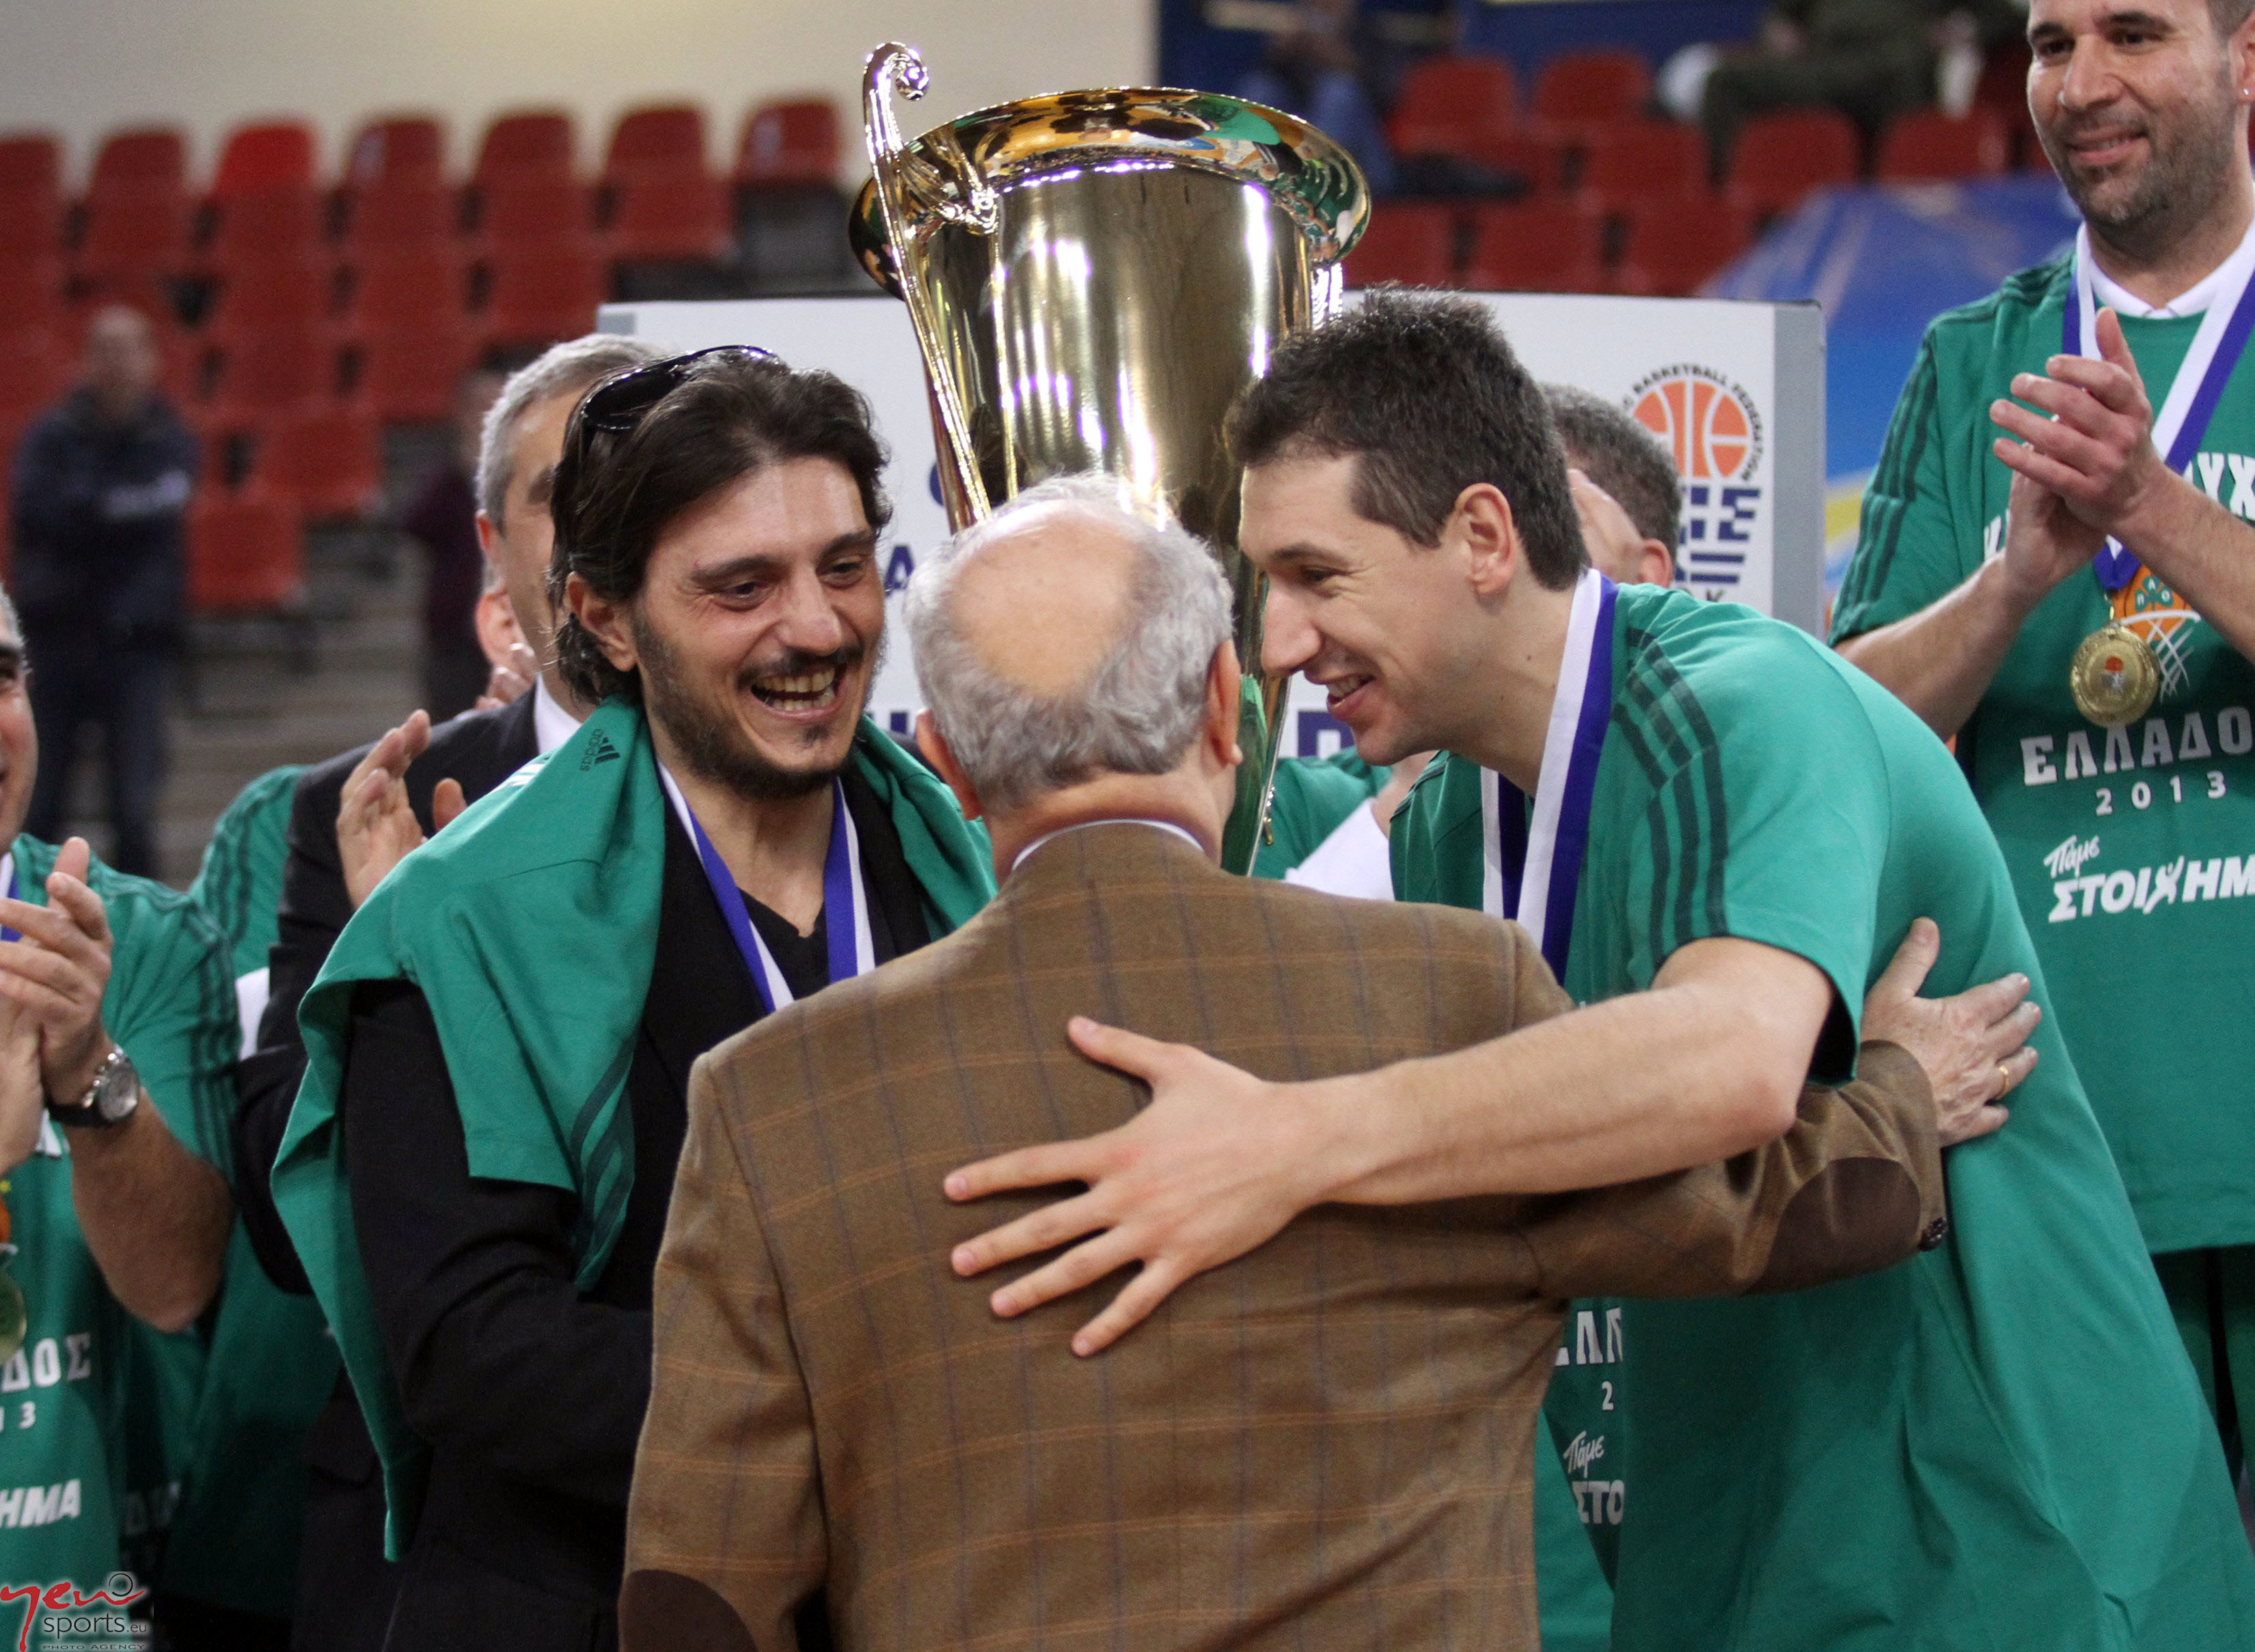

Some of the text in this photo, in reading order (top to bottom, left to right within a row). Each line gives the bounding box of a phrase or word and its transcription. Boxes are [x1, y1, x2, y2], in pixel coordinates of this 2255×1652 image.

[1632, 363, 1764, 482] BASKETBALL FEDERATION
[579, 728, 605, 771] adidas
[2096, 770, 2226, 816] 2013
